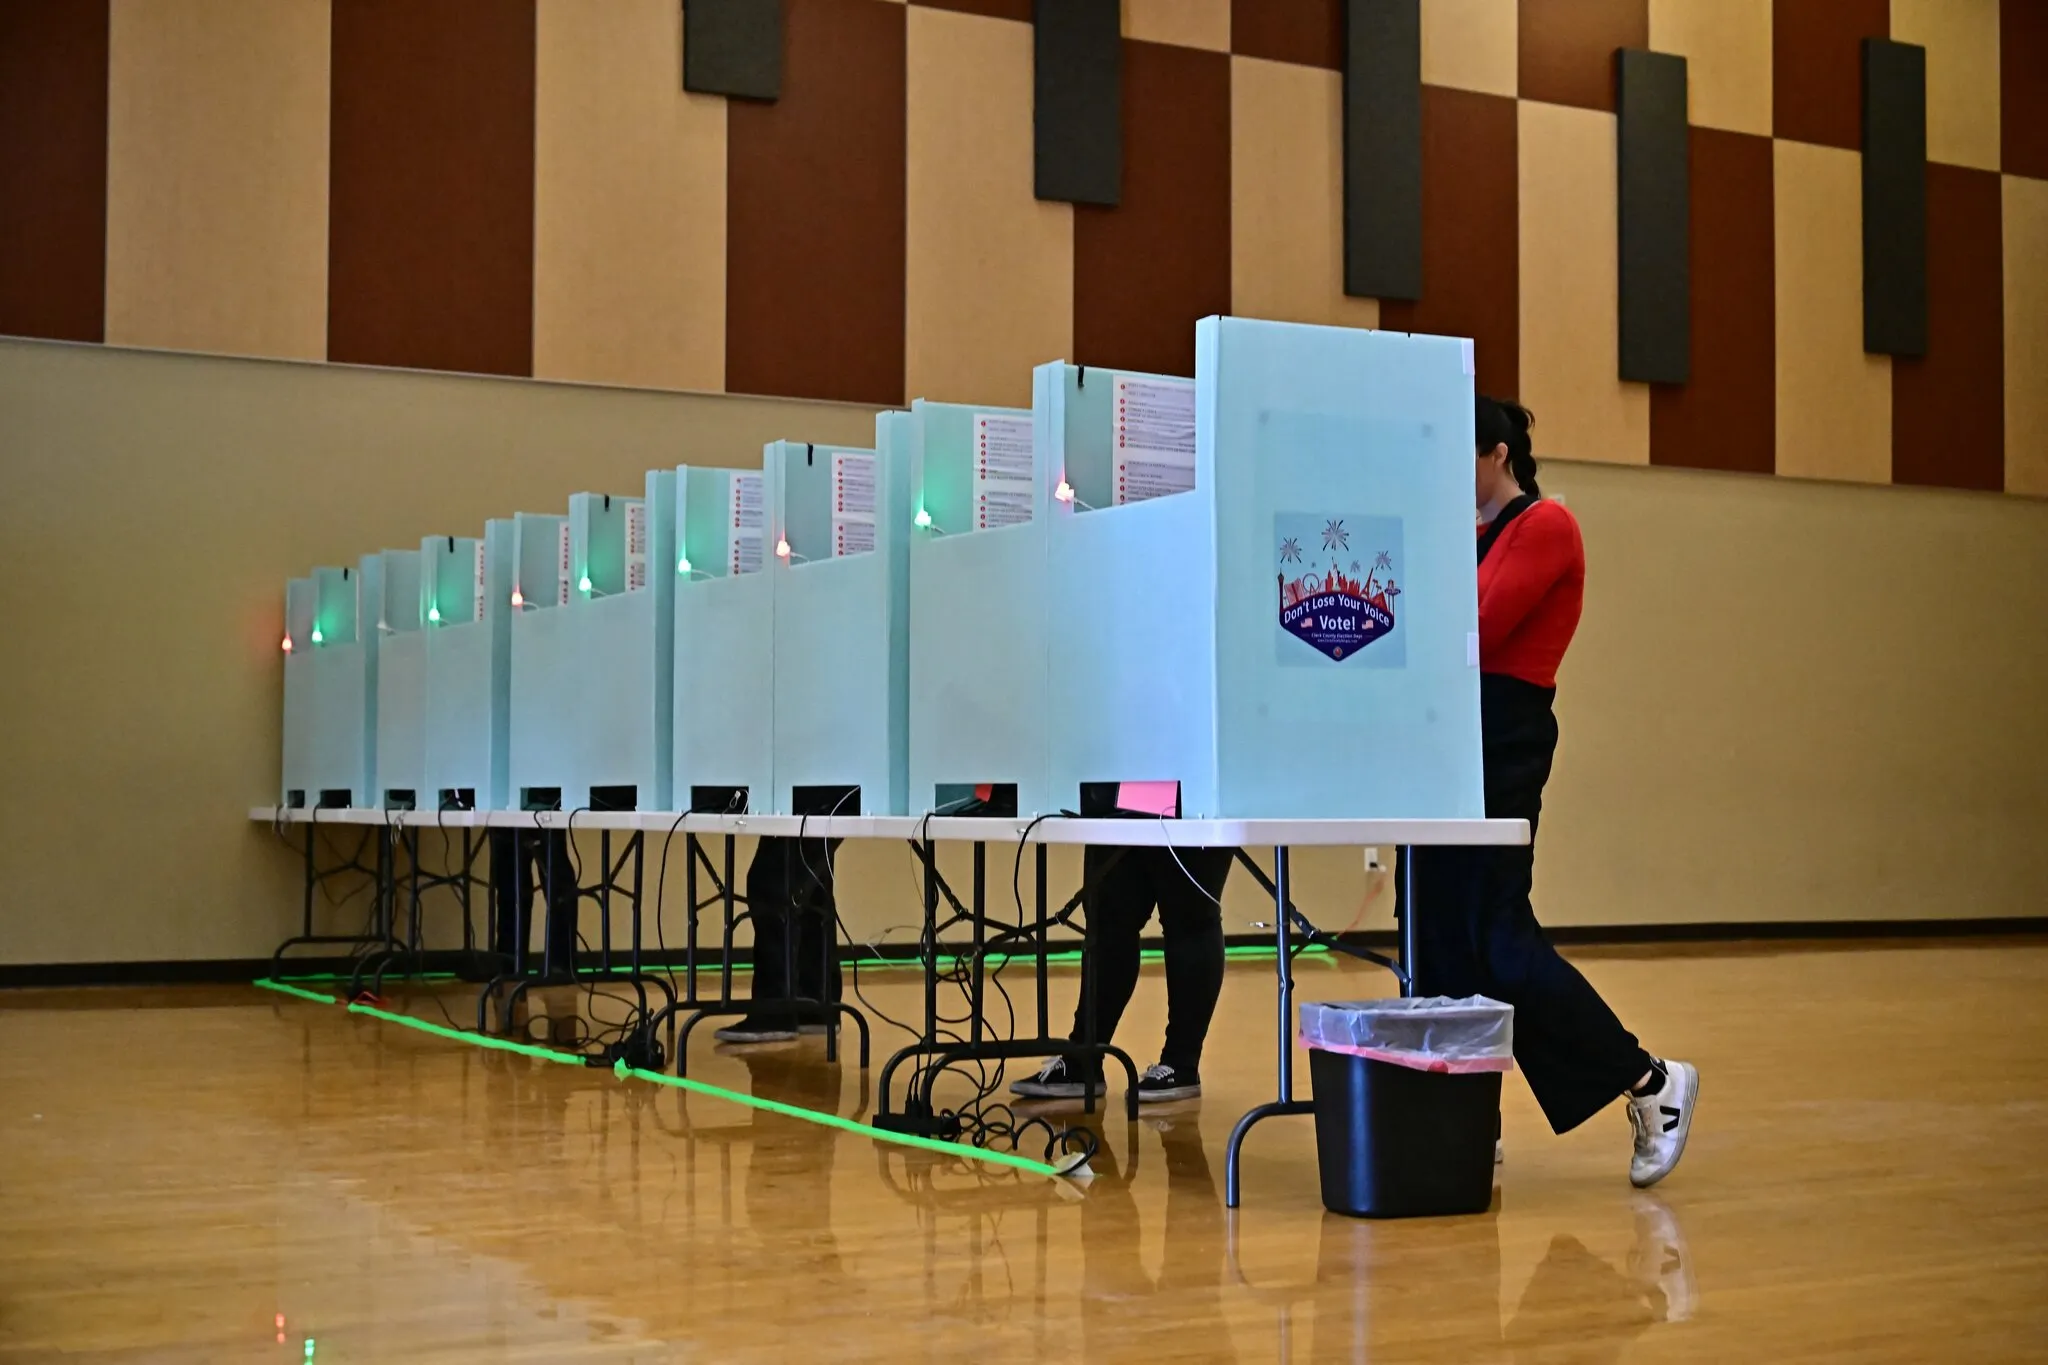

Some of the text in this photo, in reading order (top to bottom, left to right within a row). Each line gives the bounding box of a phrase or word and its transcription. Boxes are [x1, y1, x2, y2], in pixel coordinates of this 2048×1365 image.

[1284, 594, 1390, 627] Don't Lose Your Voice
[1319, 615, 1356, 631] Vote!
